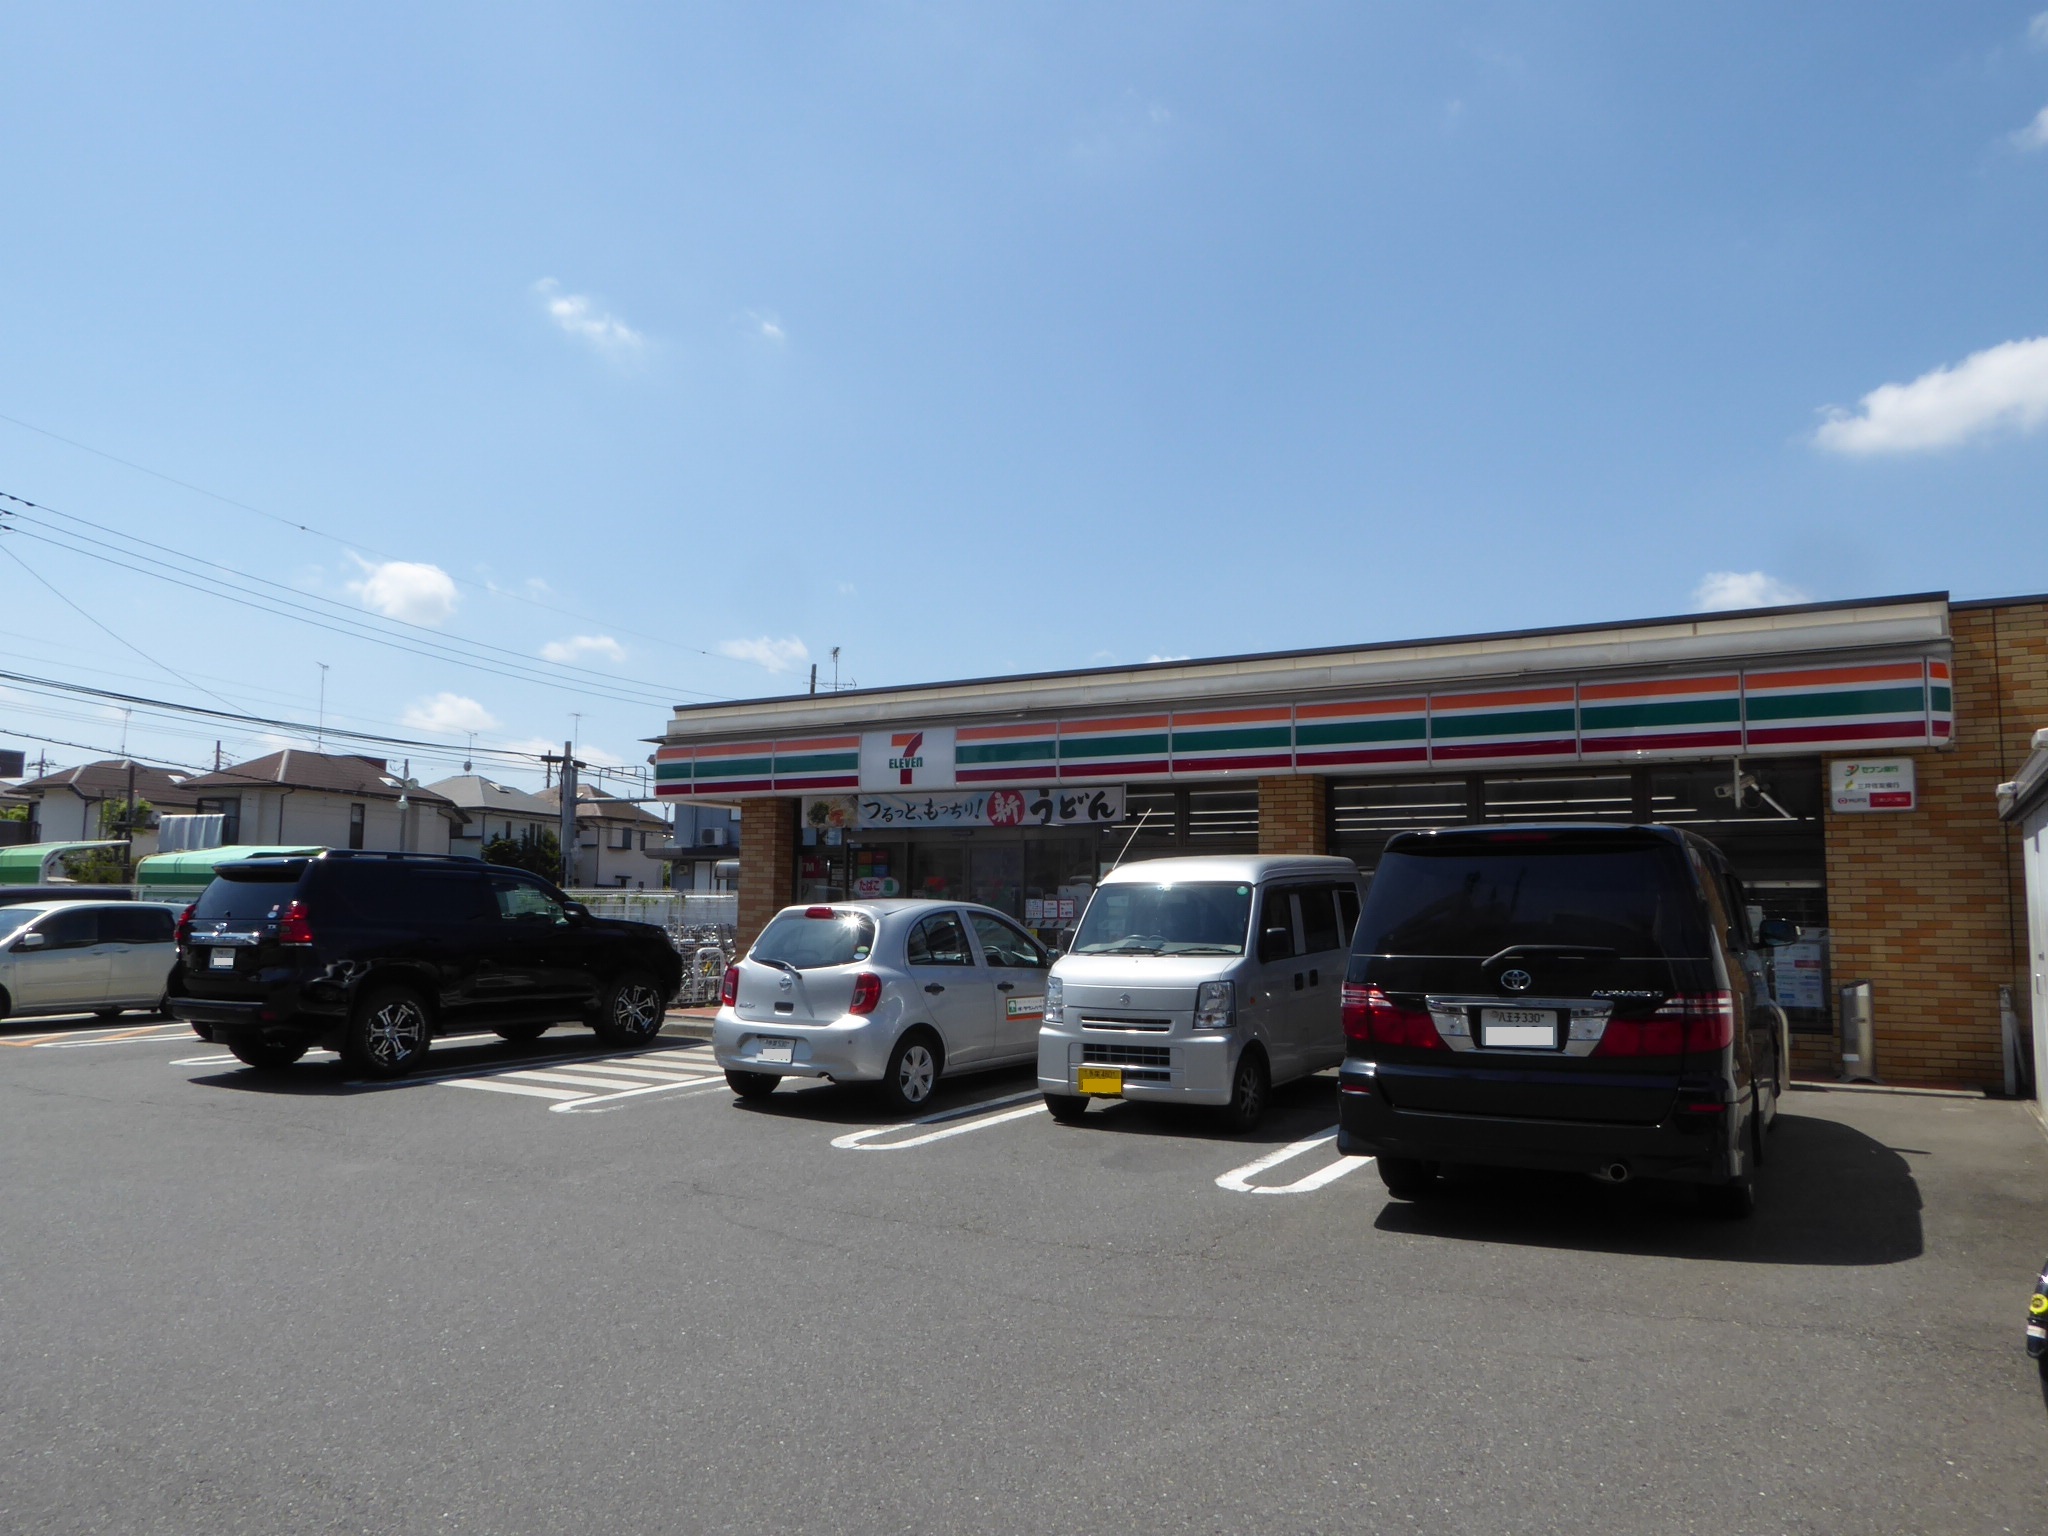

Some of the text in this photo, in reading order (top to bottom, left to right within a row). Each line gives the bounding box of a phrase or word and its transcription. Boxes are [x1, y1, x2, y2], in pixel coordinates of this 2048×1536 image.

[992, 792, 1021, 824] 新
[1030, 789, 1116, 824] うどん
[859, 880, 880, 892] たばこ
